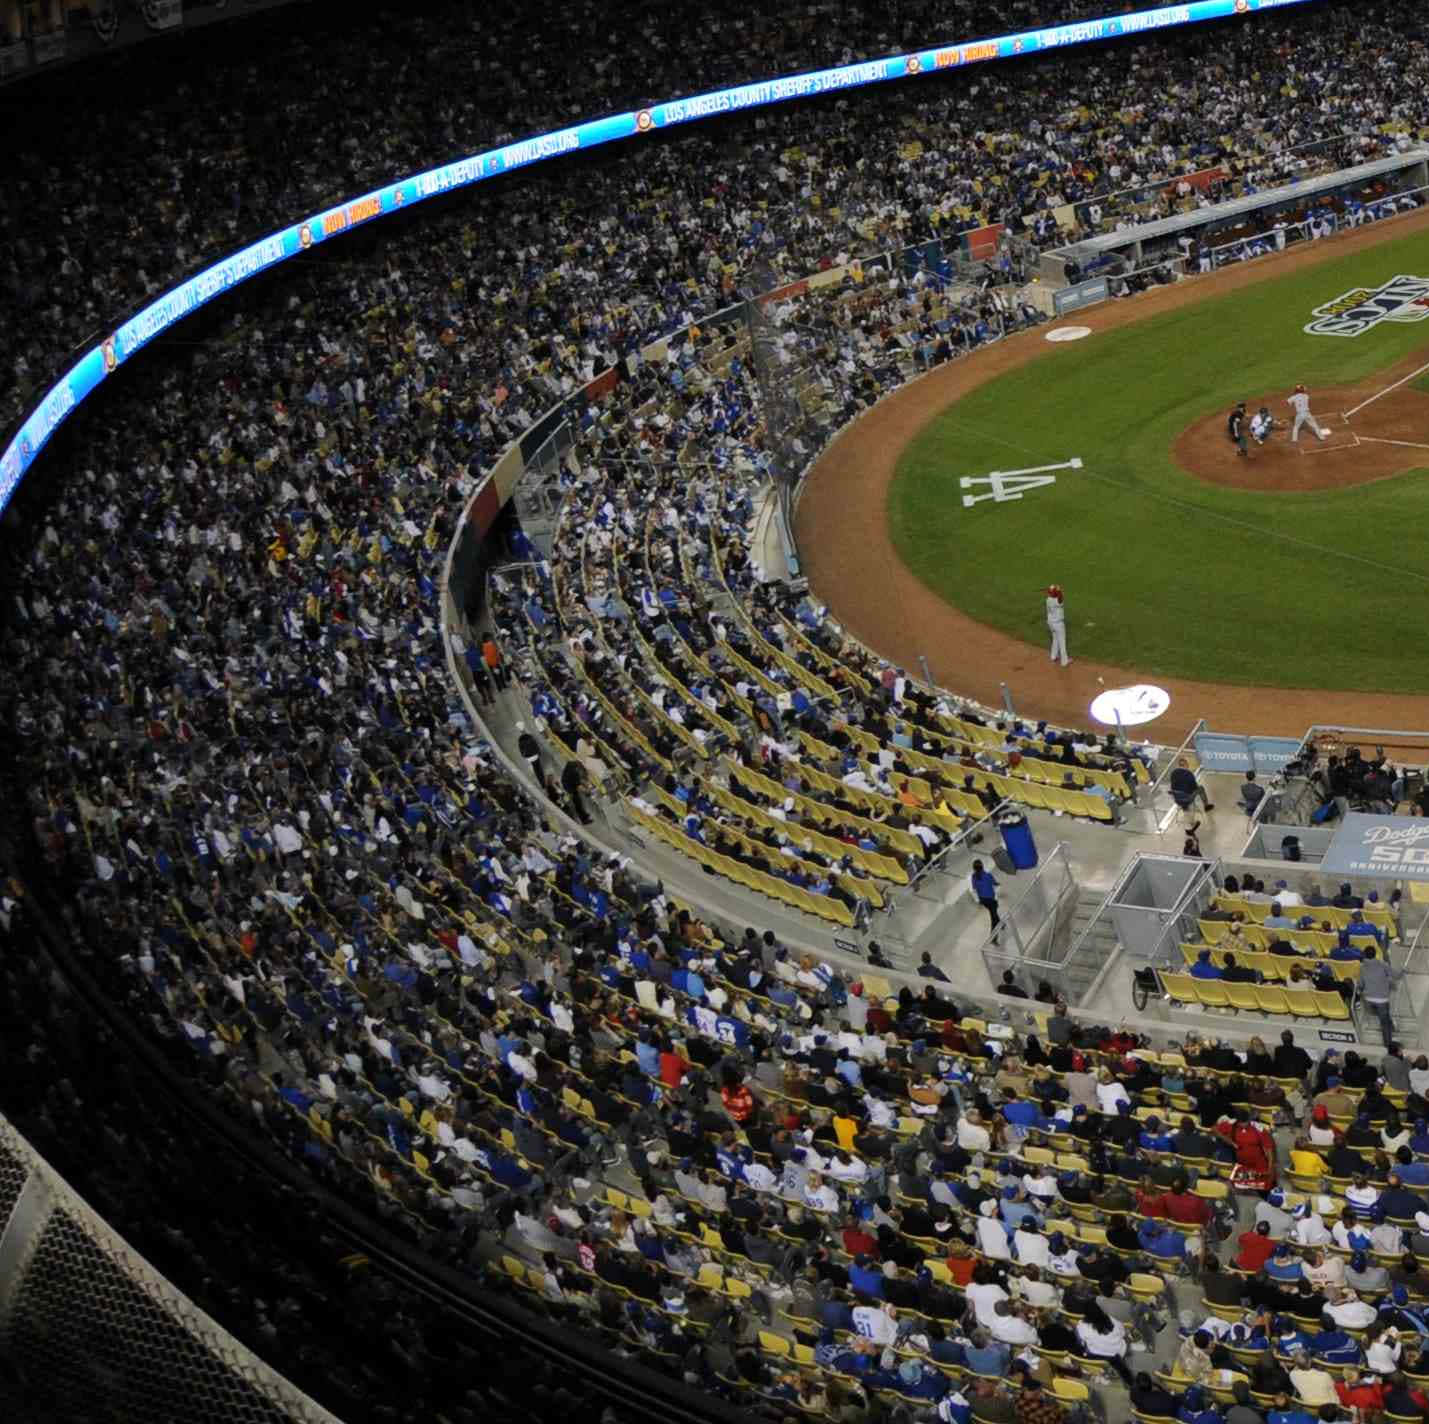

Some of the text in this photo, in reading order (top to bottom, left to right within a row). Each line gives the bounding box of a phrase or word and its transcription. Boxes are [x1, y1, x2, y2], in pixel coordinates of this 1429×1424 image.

[686, 89, 730, 119] ANGELES
[731, 81, 772, 109] COUNTY
[1214, 751, 1248, 761] TOYOTA
[857, 1321, 874, 1339] 31
